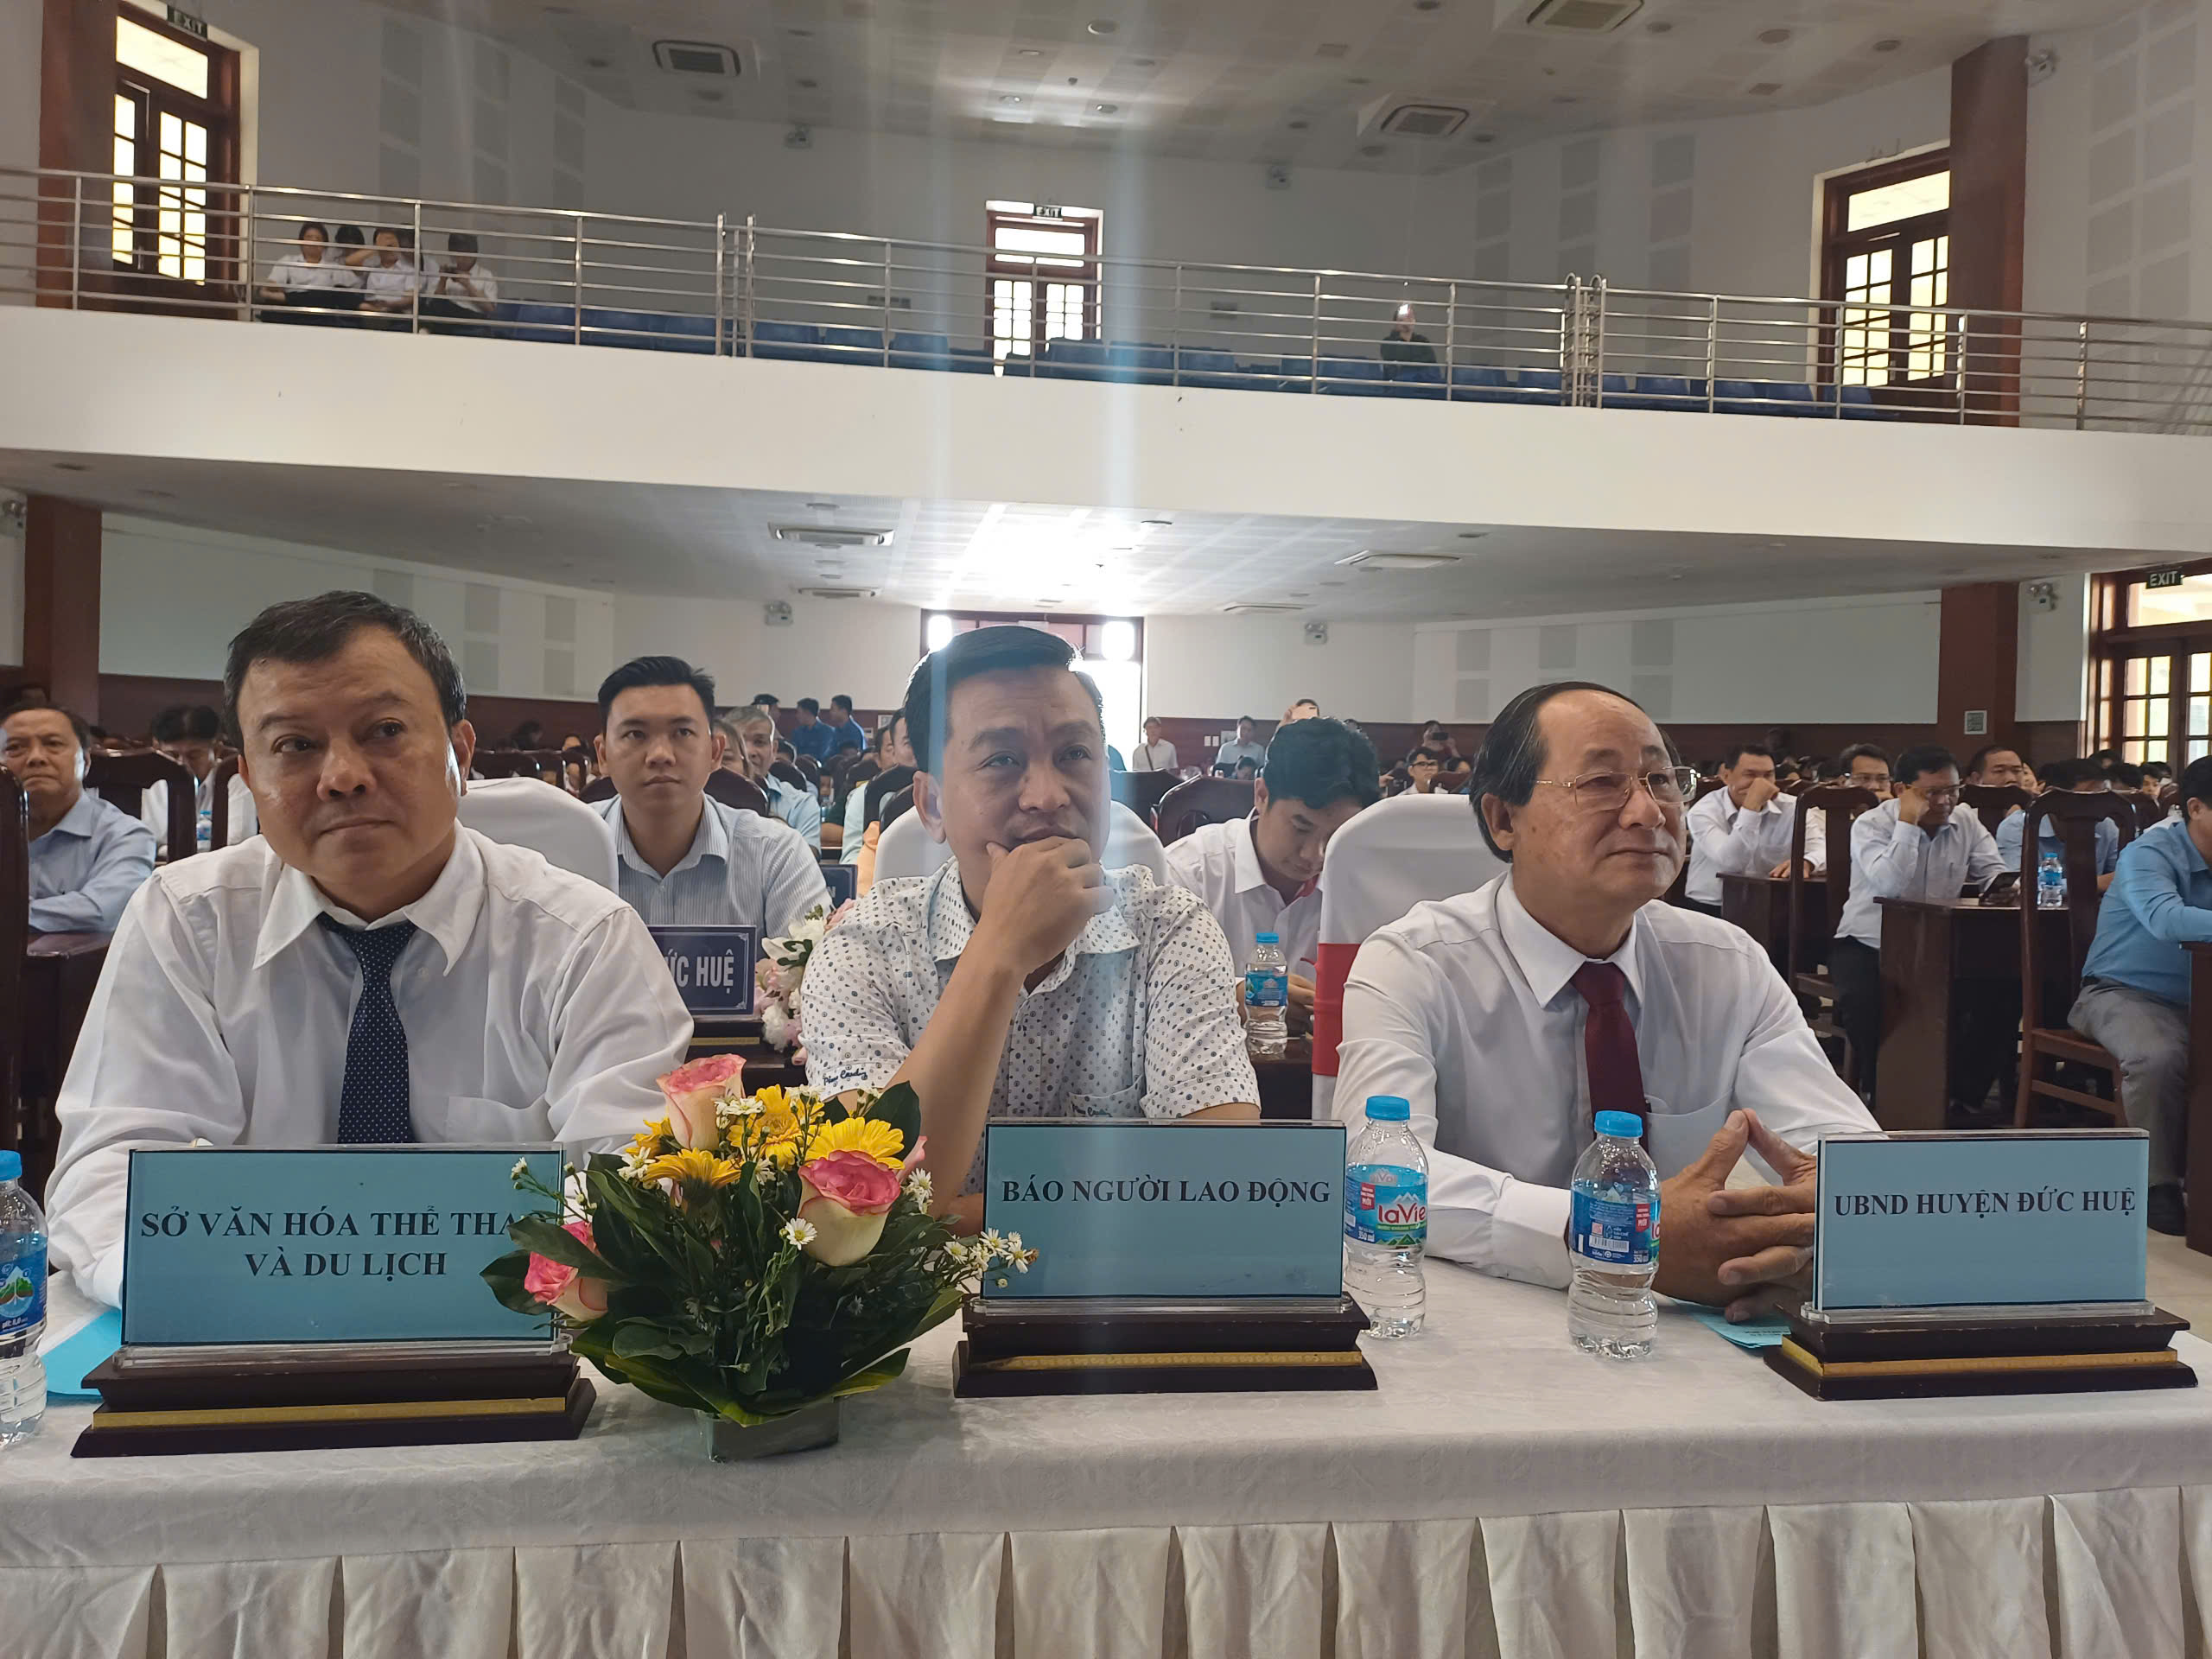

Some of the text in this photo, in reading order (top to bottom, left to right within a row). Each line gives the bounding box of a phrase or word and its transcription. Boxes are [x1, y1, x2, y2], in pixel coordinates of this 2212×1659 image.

[174, 10, 202, 34] EXIT
[1036, 207, 1059, 217] EXIT
[2150, 570, 2178, 586] EXIT
[696, 949, 734, 994] HUỆ
[1002, 1174, 1064, 1202] BÁO
[1071, 1174, 1171, 1202] NGƯỜI
[1179, 1180, 1240, 1202] LAO
[1247, 1178, 1331, 1208] ĐỘNG
[1834, 1185, 2136, 1218] UBND HUYỆN ĐỨC HUỆ
[141, 1205, 544, 1236] SỞ VĂN HÓA THỂ THA
[245, 1246, 448, 1282] VÀ DU LỊCH
